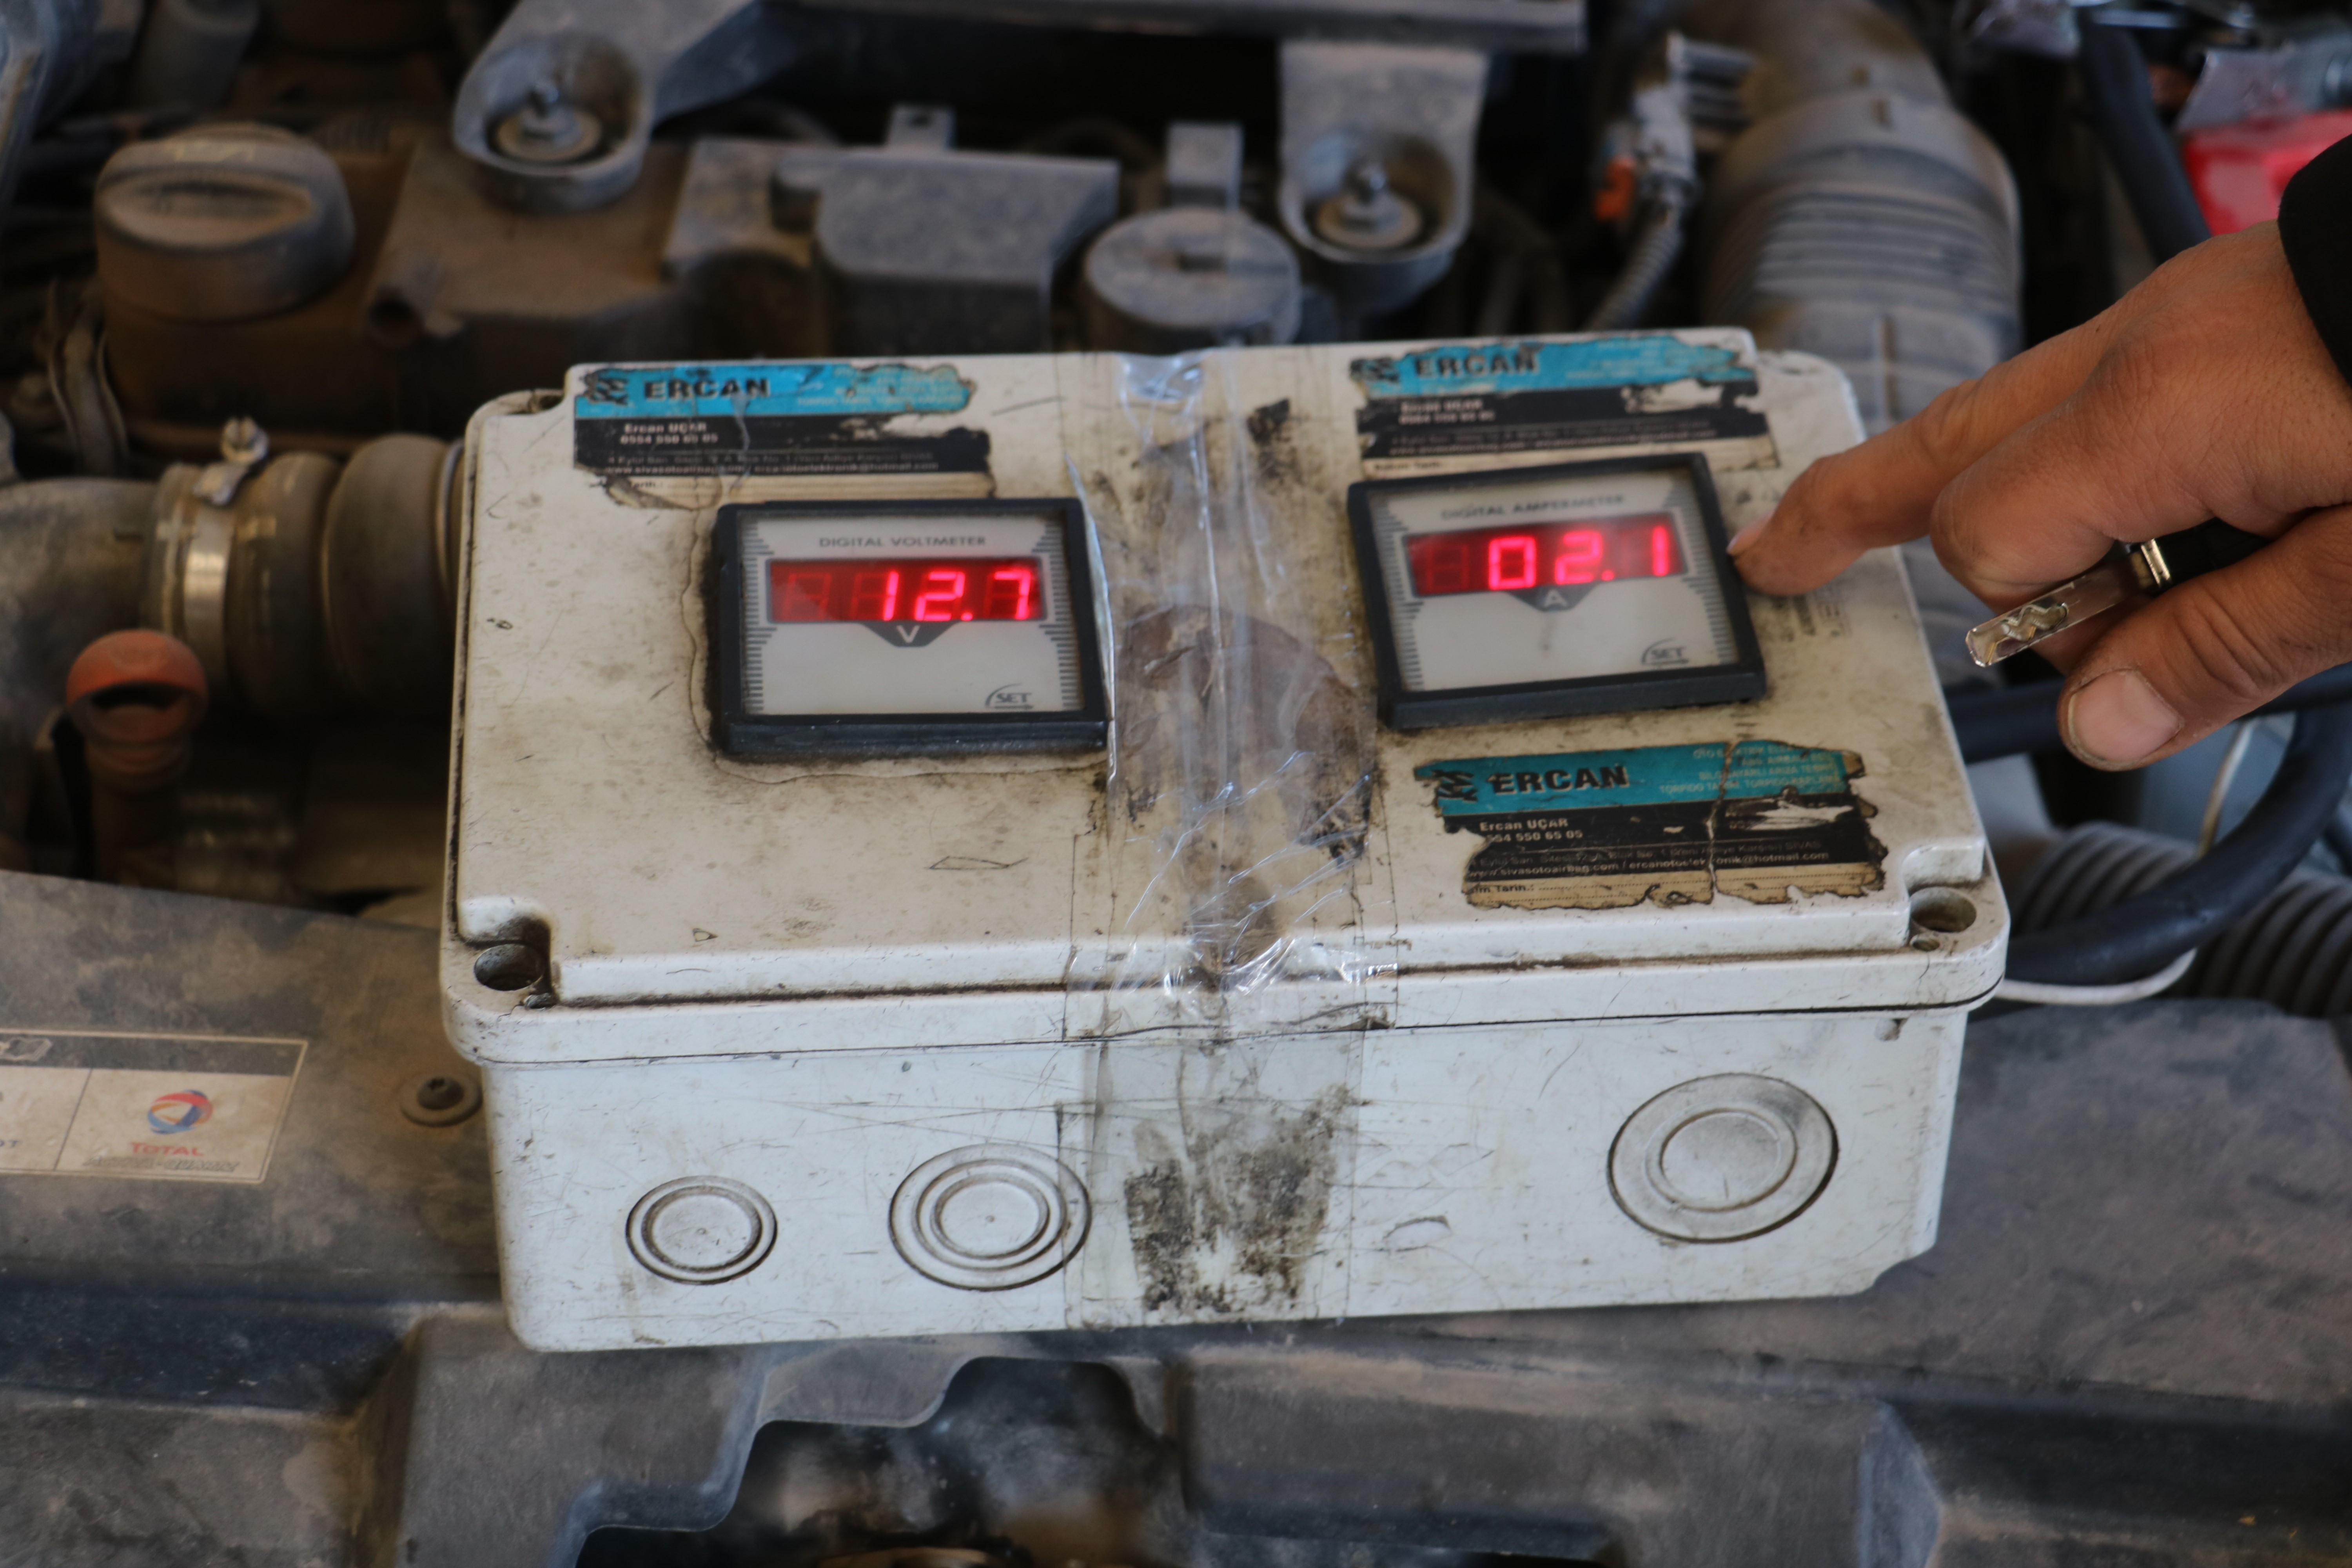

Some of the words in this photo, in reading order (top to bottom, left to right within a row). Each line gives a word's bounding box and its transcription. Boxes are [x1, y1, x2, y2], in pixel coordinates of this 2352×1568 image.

[1415, 350, 1539, 378] ERCAN
[644, 378, 769, 401] ERCAN
[819, 536, 883, 547] DIGITAL
[891, 535, 987, 546] VOLTMETER
[1487, 524, 1669, 591] 02.1
[882, 570, 1032, 622] 12.7
[1543, 590, 1567, 608] A
[896, 625, 920, 643] V
[1650, 646, 1687, 660] SET
[996, 691, 1033, 705] SET
[1492, 766, 1630, 795] ERCAN
[1479, 822, 1523, 832] Ercan
[1526, 818, 1568, 830] UÇAR
[129, 1141, 205, 1156] TOTAL
